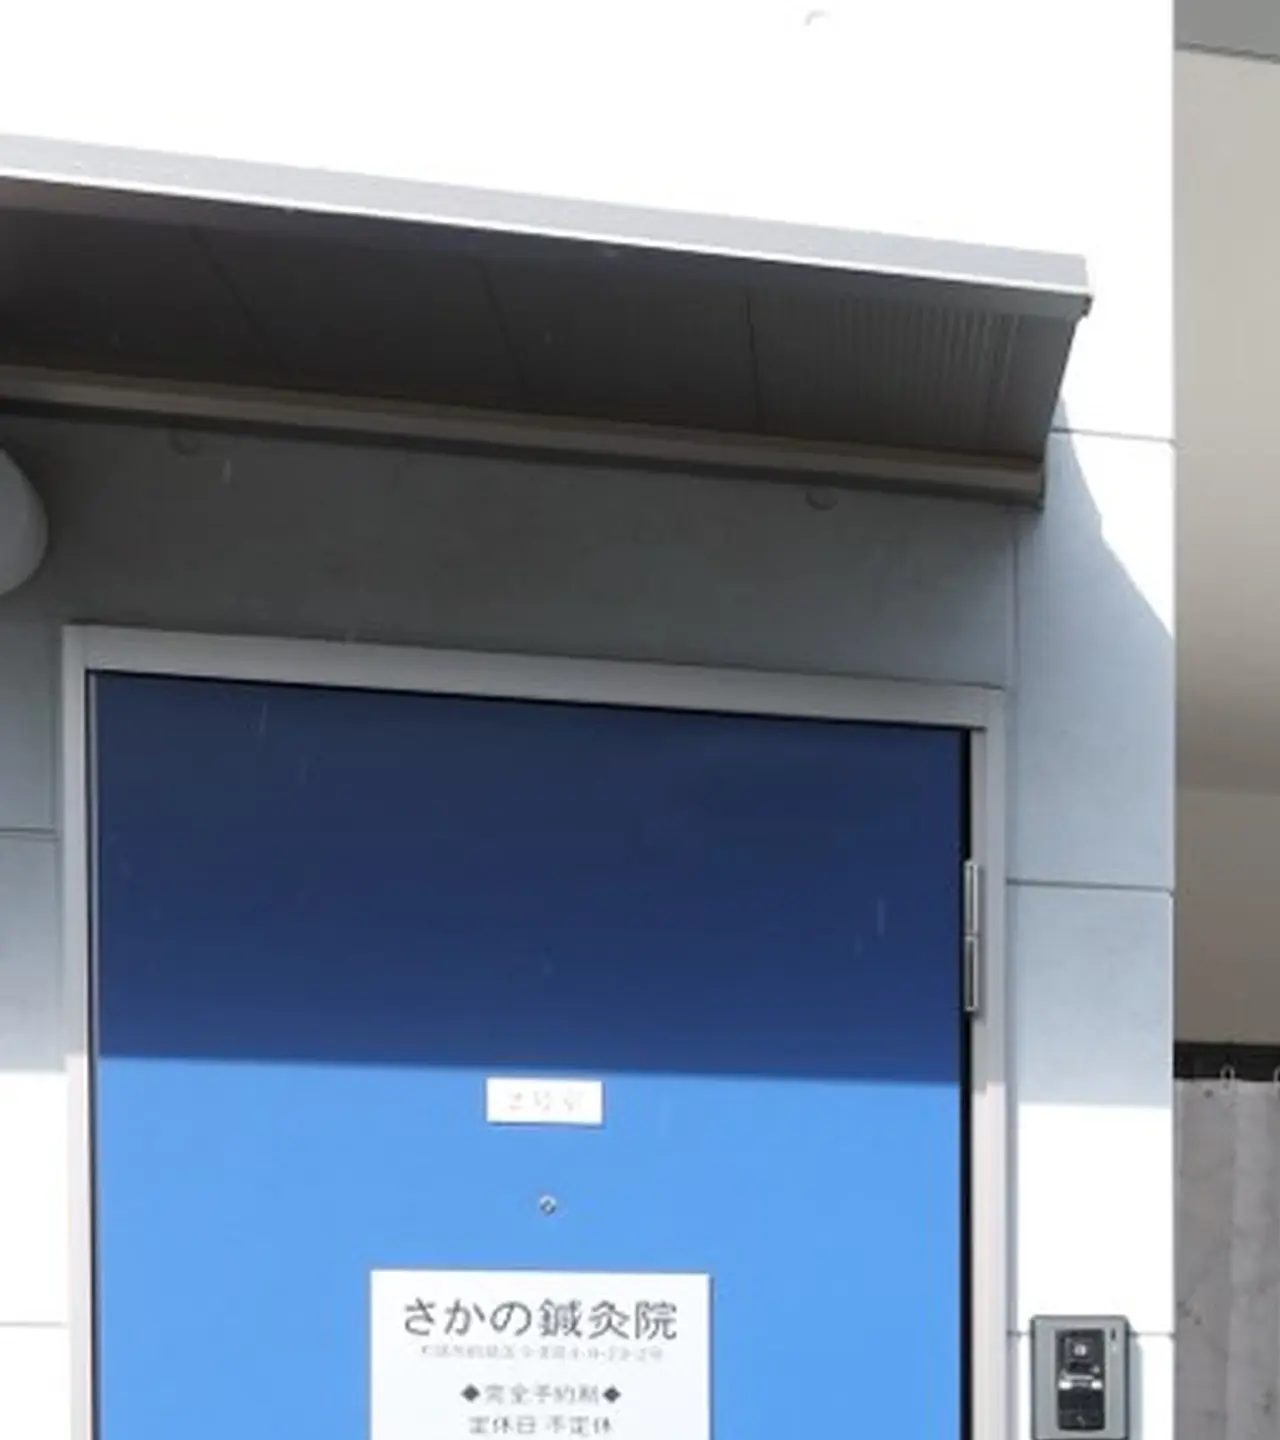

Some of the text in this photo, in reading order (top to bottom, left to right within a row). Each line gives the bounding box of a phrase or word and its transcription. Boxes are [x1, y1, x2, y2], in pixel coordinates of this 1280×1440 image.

[403, 1296, 678, 1340] さかの鍼灸院
[467, 1414, 538, 1436] 定休日
